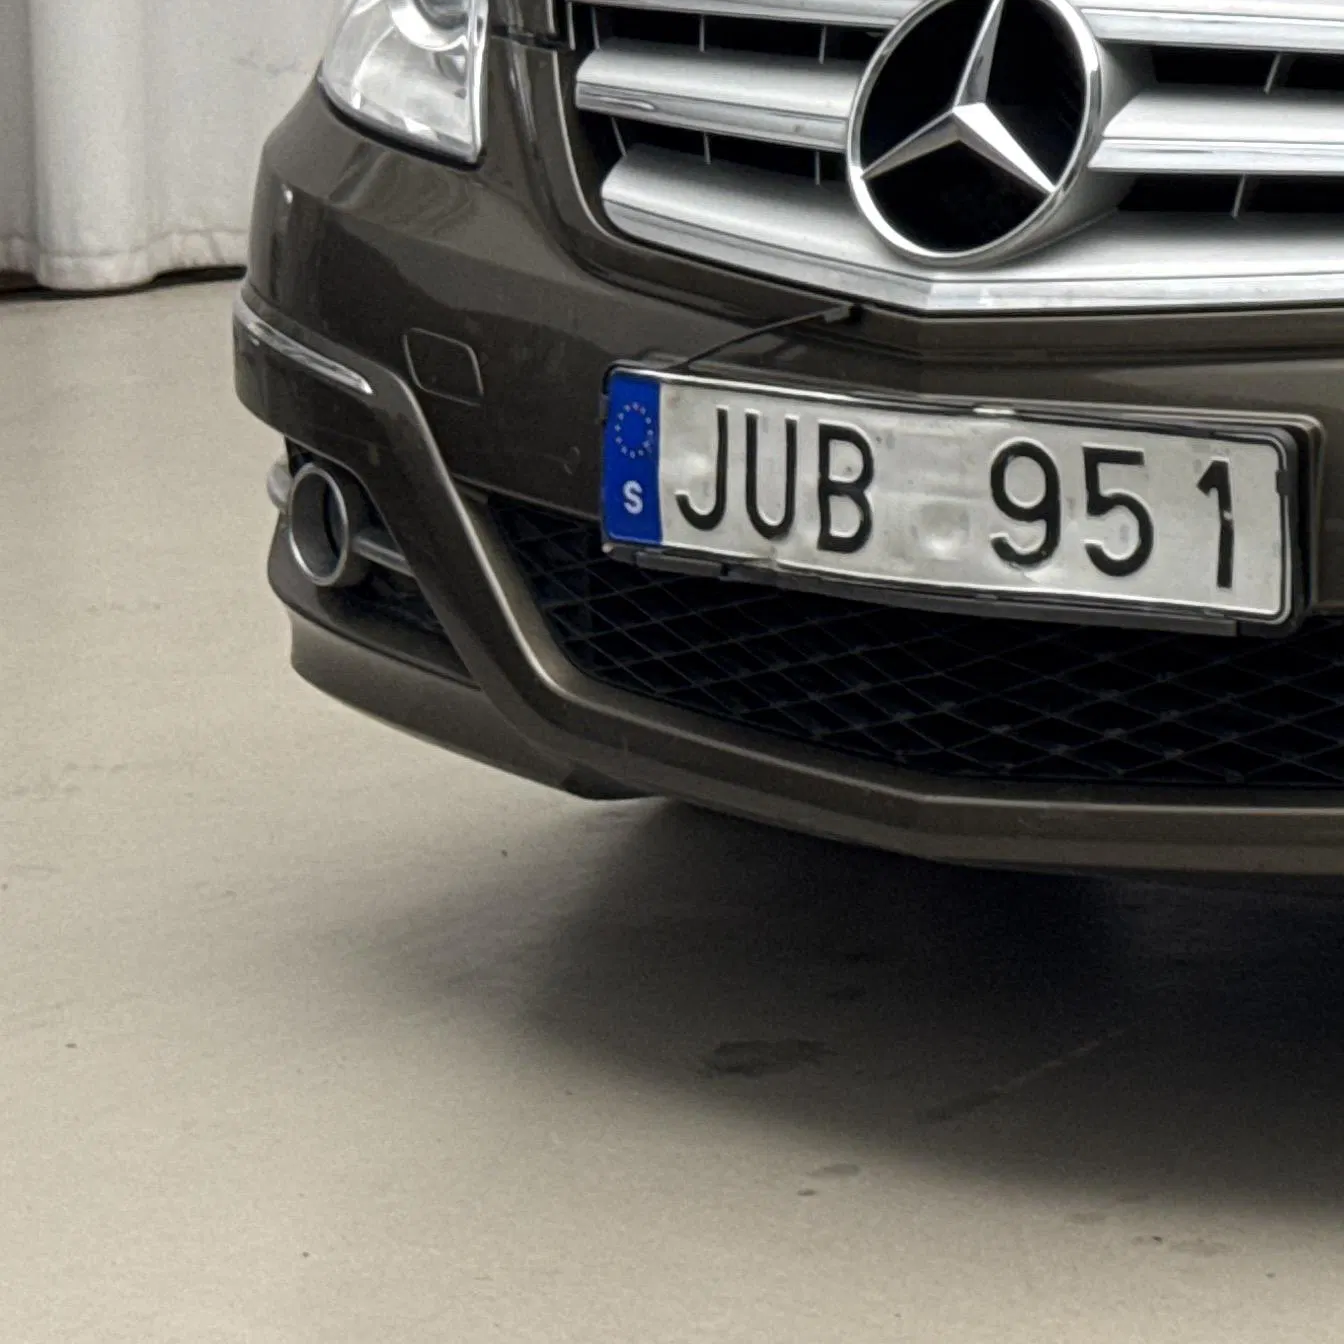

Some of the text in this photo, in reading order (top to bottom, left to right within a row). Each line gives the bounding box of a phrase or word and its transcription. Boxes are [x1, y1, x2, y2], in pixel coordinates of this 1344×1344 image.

[623, 480, 643, 514] S
[675, 407, 1234, 589] JUB 951
